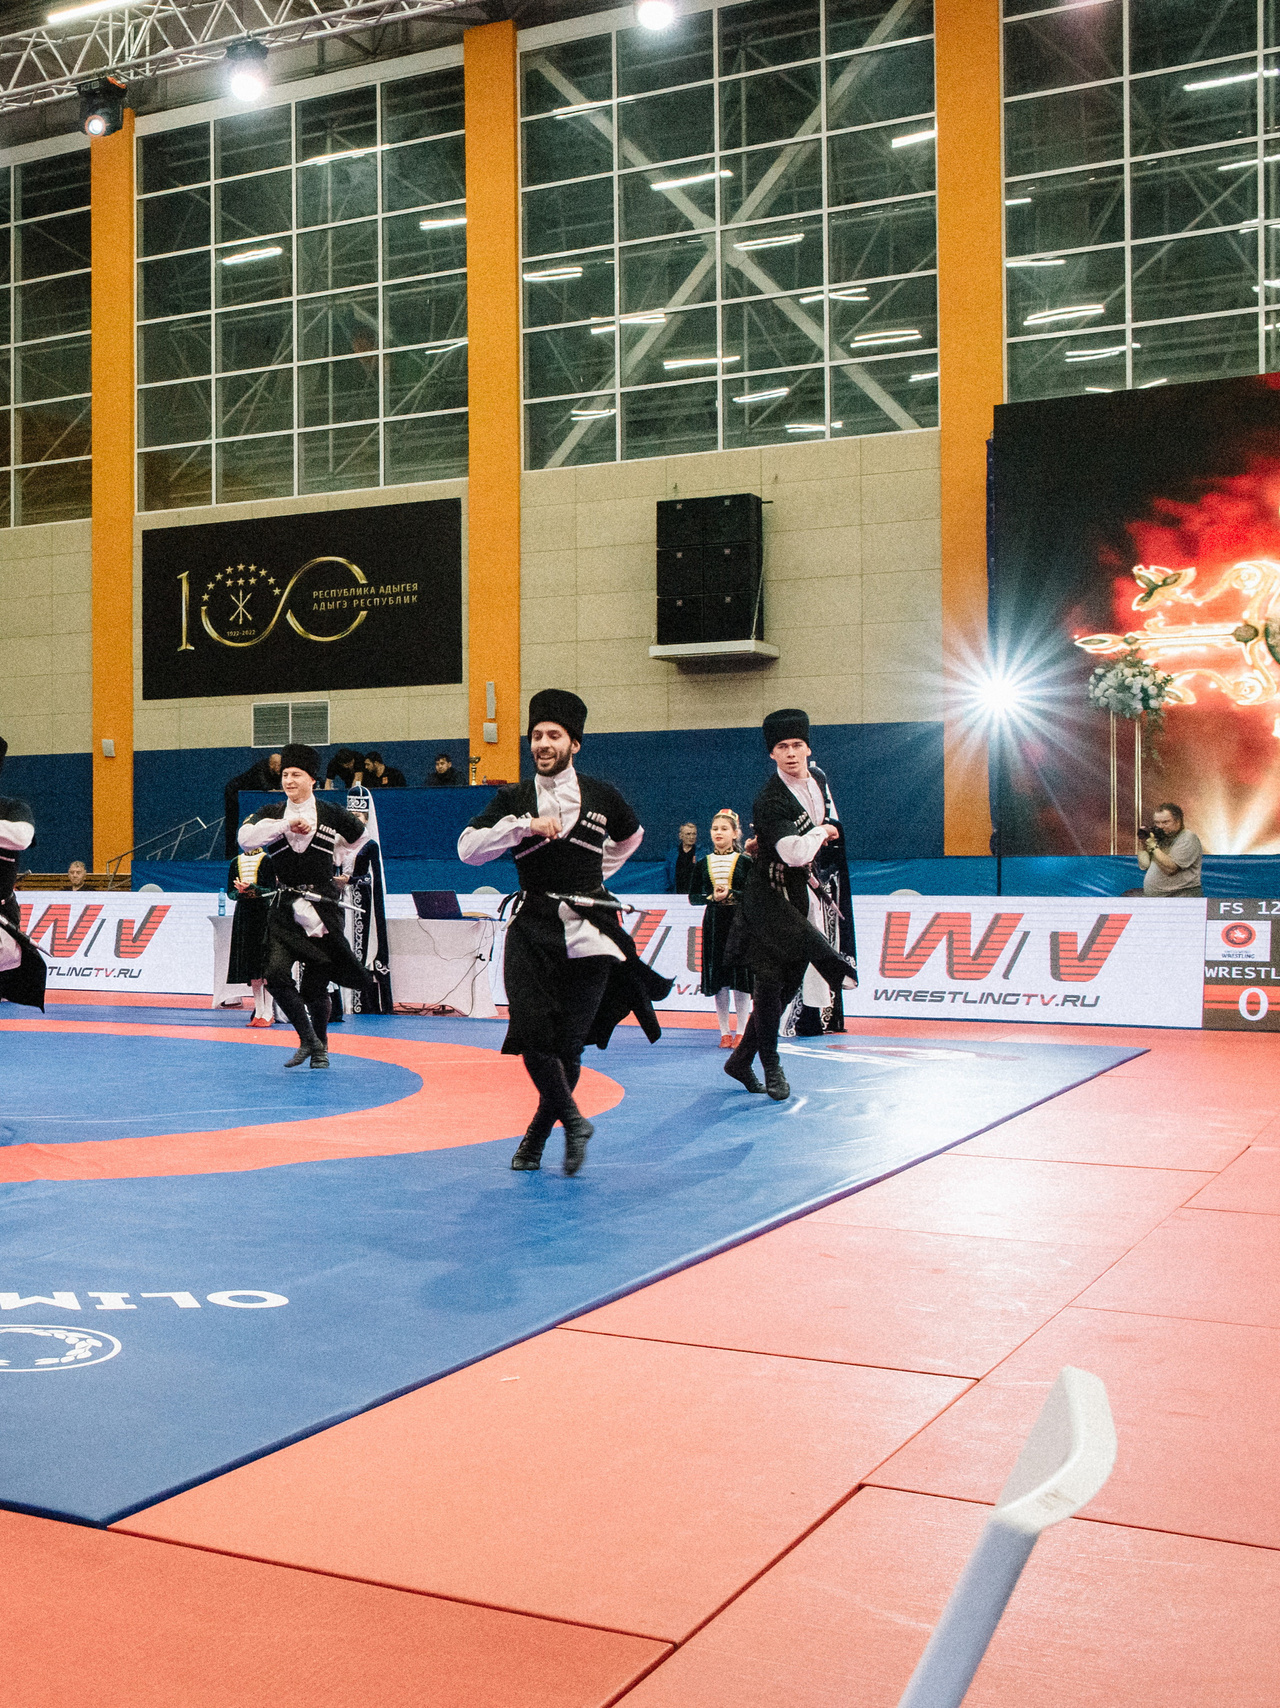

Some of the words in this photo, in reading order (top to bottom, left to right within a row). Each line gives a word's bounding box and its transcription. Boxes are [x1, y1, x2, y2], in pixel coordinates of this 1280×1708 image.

[312, 586, 376, 599] РЕСПУБЛИКА
[379, 583, 418, 595] АДЫГЕЯ
[312, 600, 348, 611] АДЫГЭ
[353, 594, 418, 608] РЕСПУБЛИК
[1220, 902, 1244, 914] FS
[47, 966, 142, 979] TLINGTV.RU
[1204, 966, 1280, 980] WRESTL
[873, 988, 1101, 1008] WRESTLINGTV.RU
[1238, 987, 1269, 1021] 0
